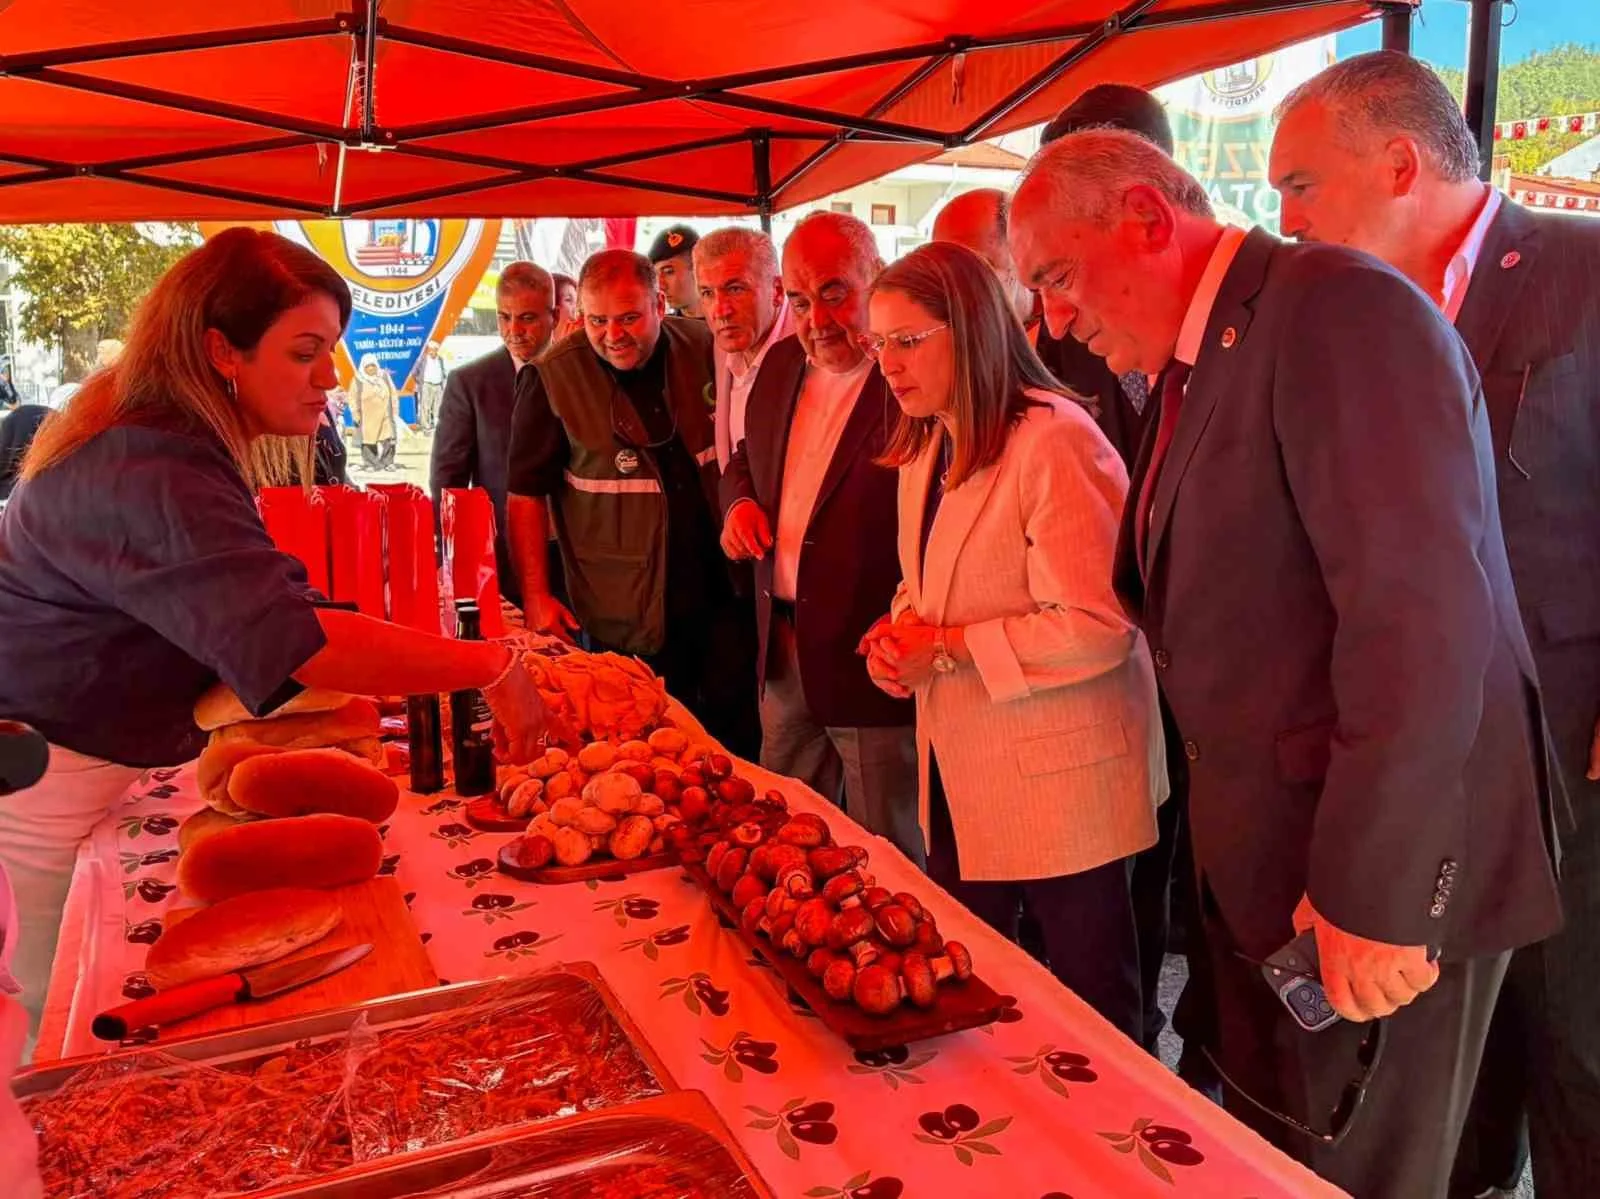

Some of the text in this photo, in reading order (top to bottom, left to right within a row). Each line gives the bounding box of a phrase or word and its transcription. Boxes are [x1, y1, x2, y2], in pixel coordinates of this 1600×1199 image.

[385, 266, 409, 275] 1944
[352, 277, 441, 309] ELEDİYESİ
[380, 324, 405, 335] 1944
